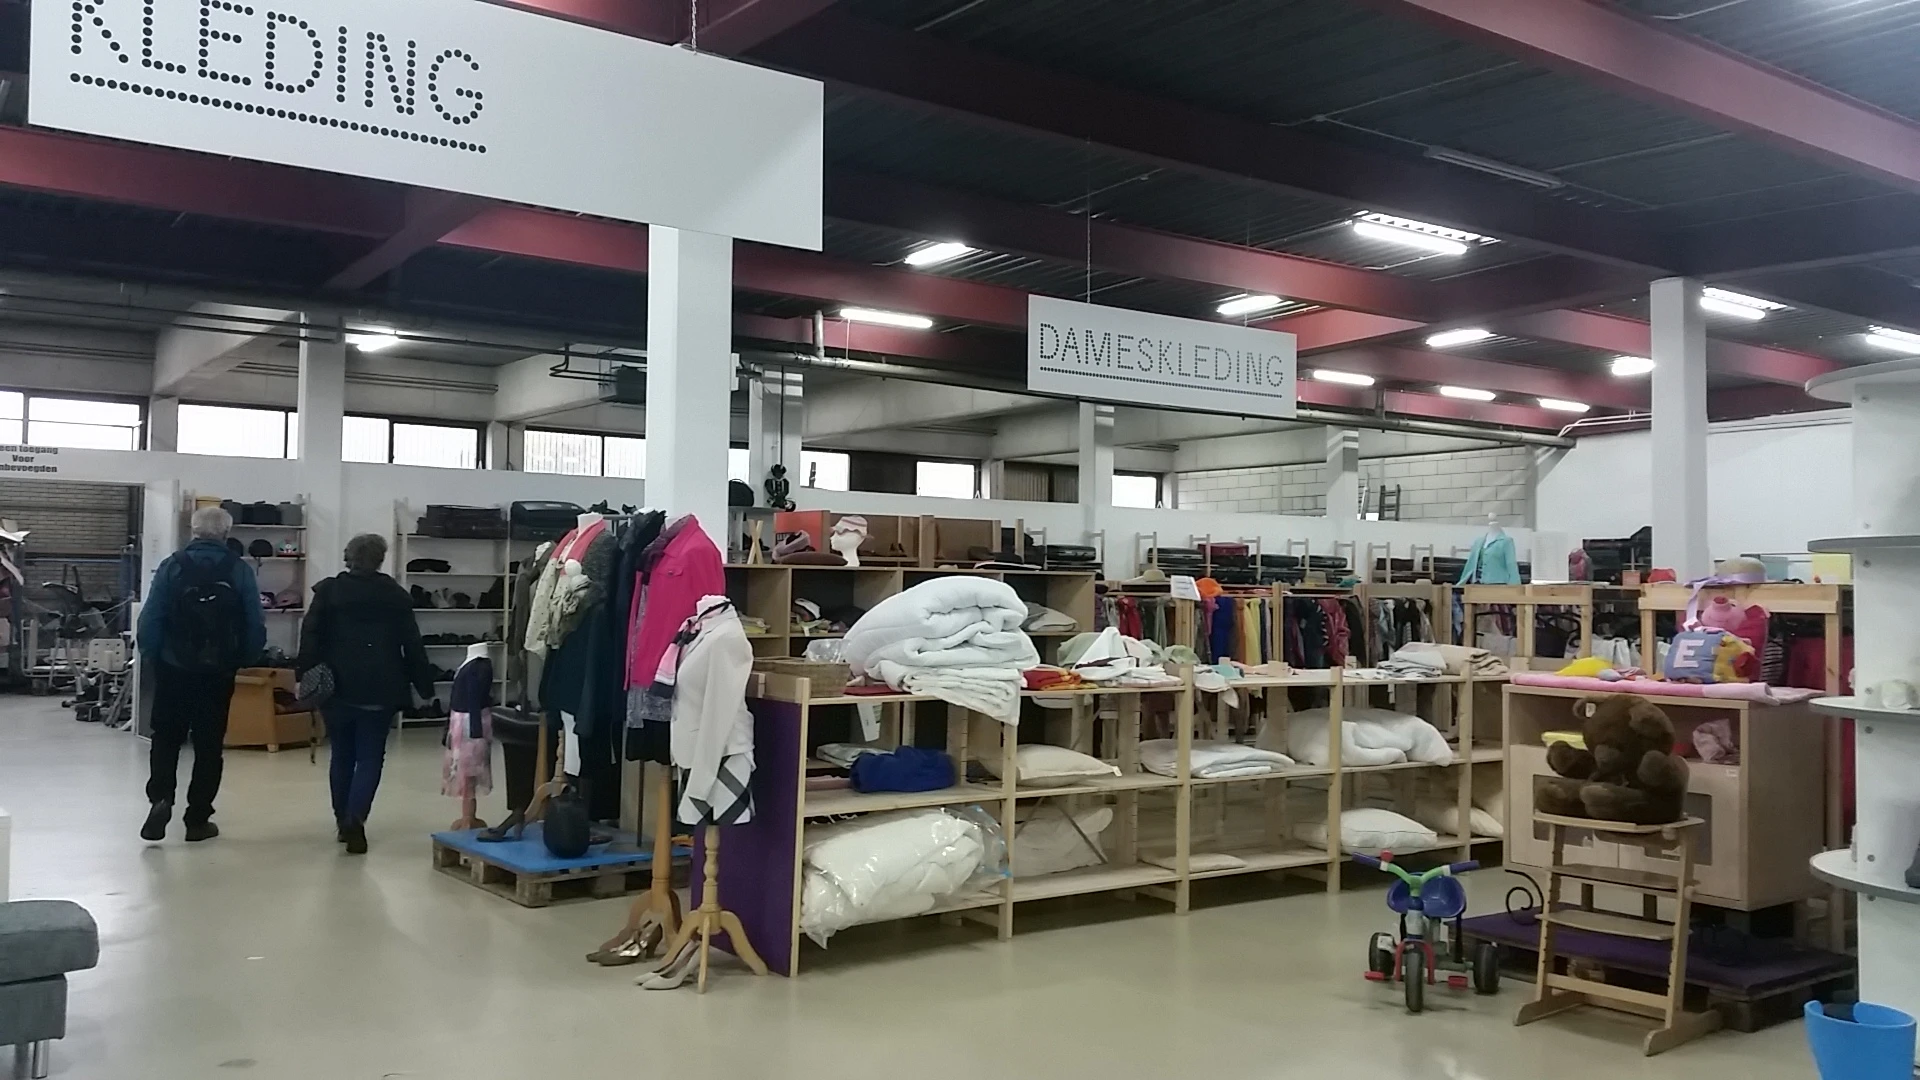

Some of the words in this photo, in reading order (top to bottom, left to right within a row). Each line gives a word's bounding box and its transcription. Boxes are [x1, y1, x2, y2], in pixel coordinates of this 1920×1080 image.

[71, 0, 484, 125] KLEDING
[1040, 323, 1284, 387] DAMESKLEDING
[12, 454, 35, 463] Voor
[19, 445, 59, 455] toegang
[1673, 639, 1705, 668] E
